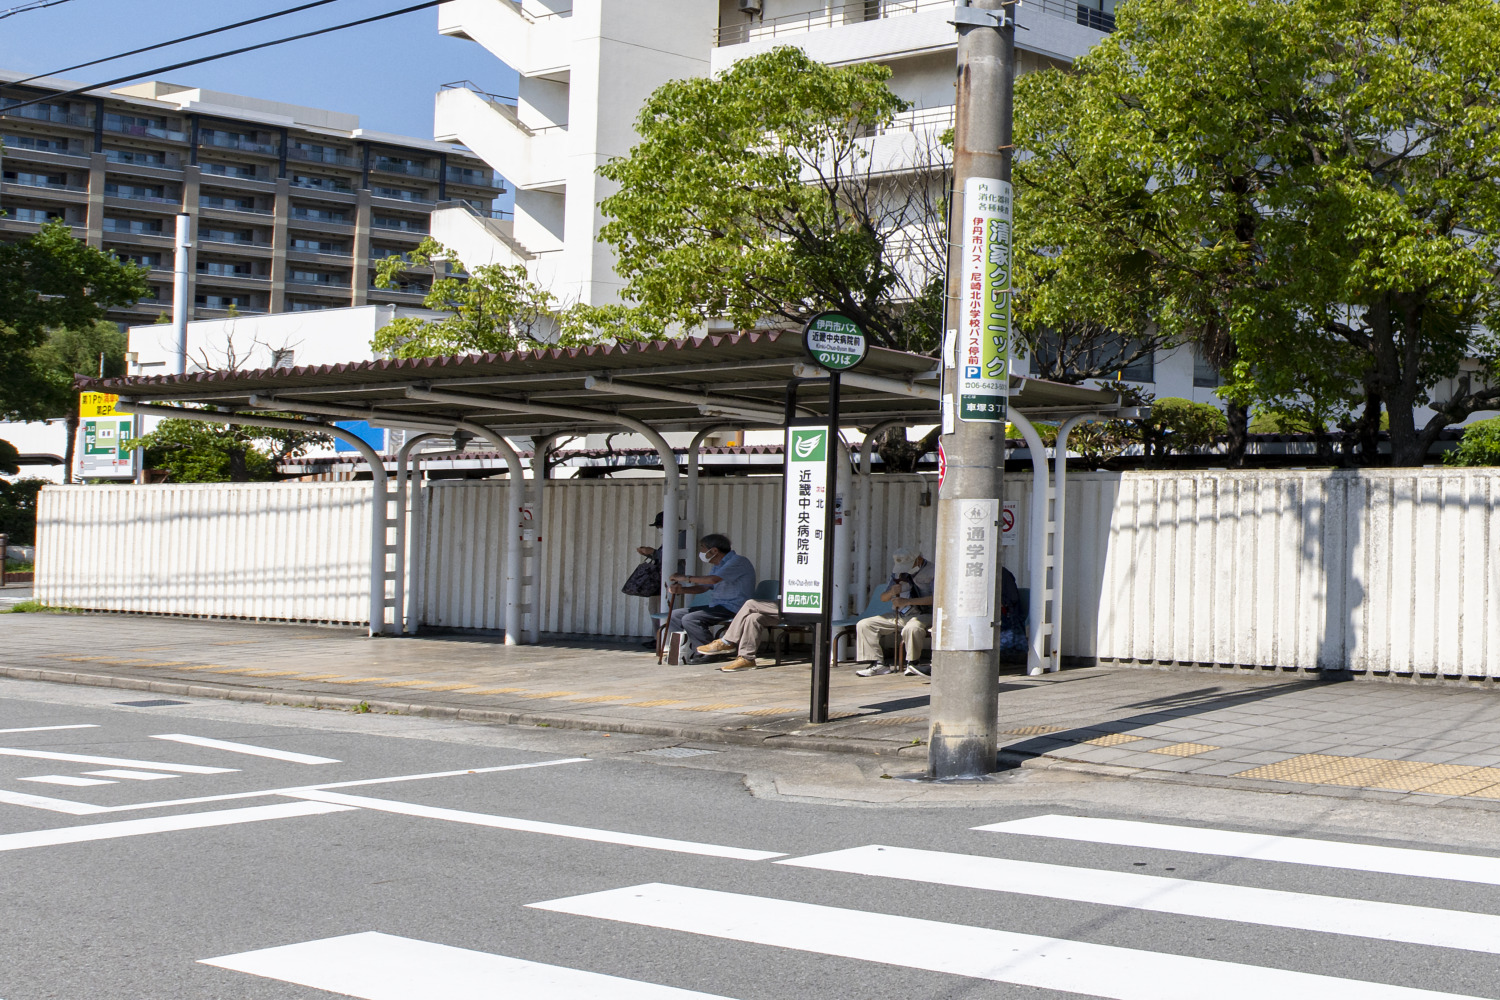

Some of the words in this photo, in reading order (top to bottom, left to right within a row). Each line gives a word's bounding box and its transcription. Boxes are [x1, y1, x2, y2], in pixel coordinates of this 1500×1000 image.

[986, 219, 1009, 377] 清家クリニック
[816, 319, 857, 334] 伊丹市バス
[812, 331, 861, 347] 近畿中央病院前
[819, 352, 851, 365] のりば
[96, 405, 115, 416] 第2P
[797, 469, 811, 565] 近畿中央病院前
[966, 526, 985, 578] 通学路
[788, 594, 820, 606] 伊丹市バス
